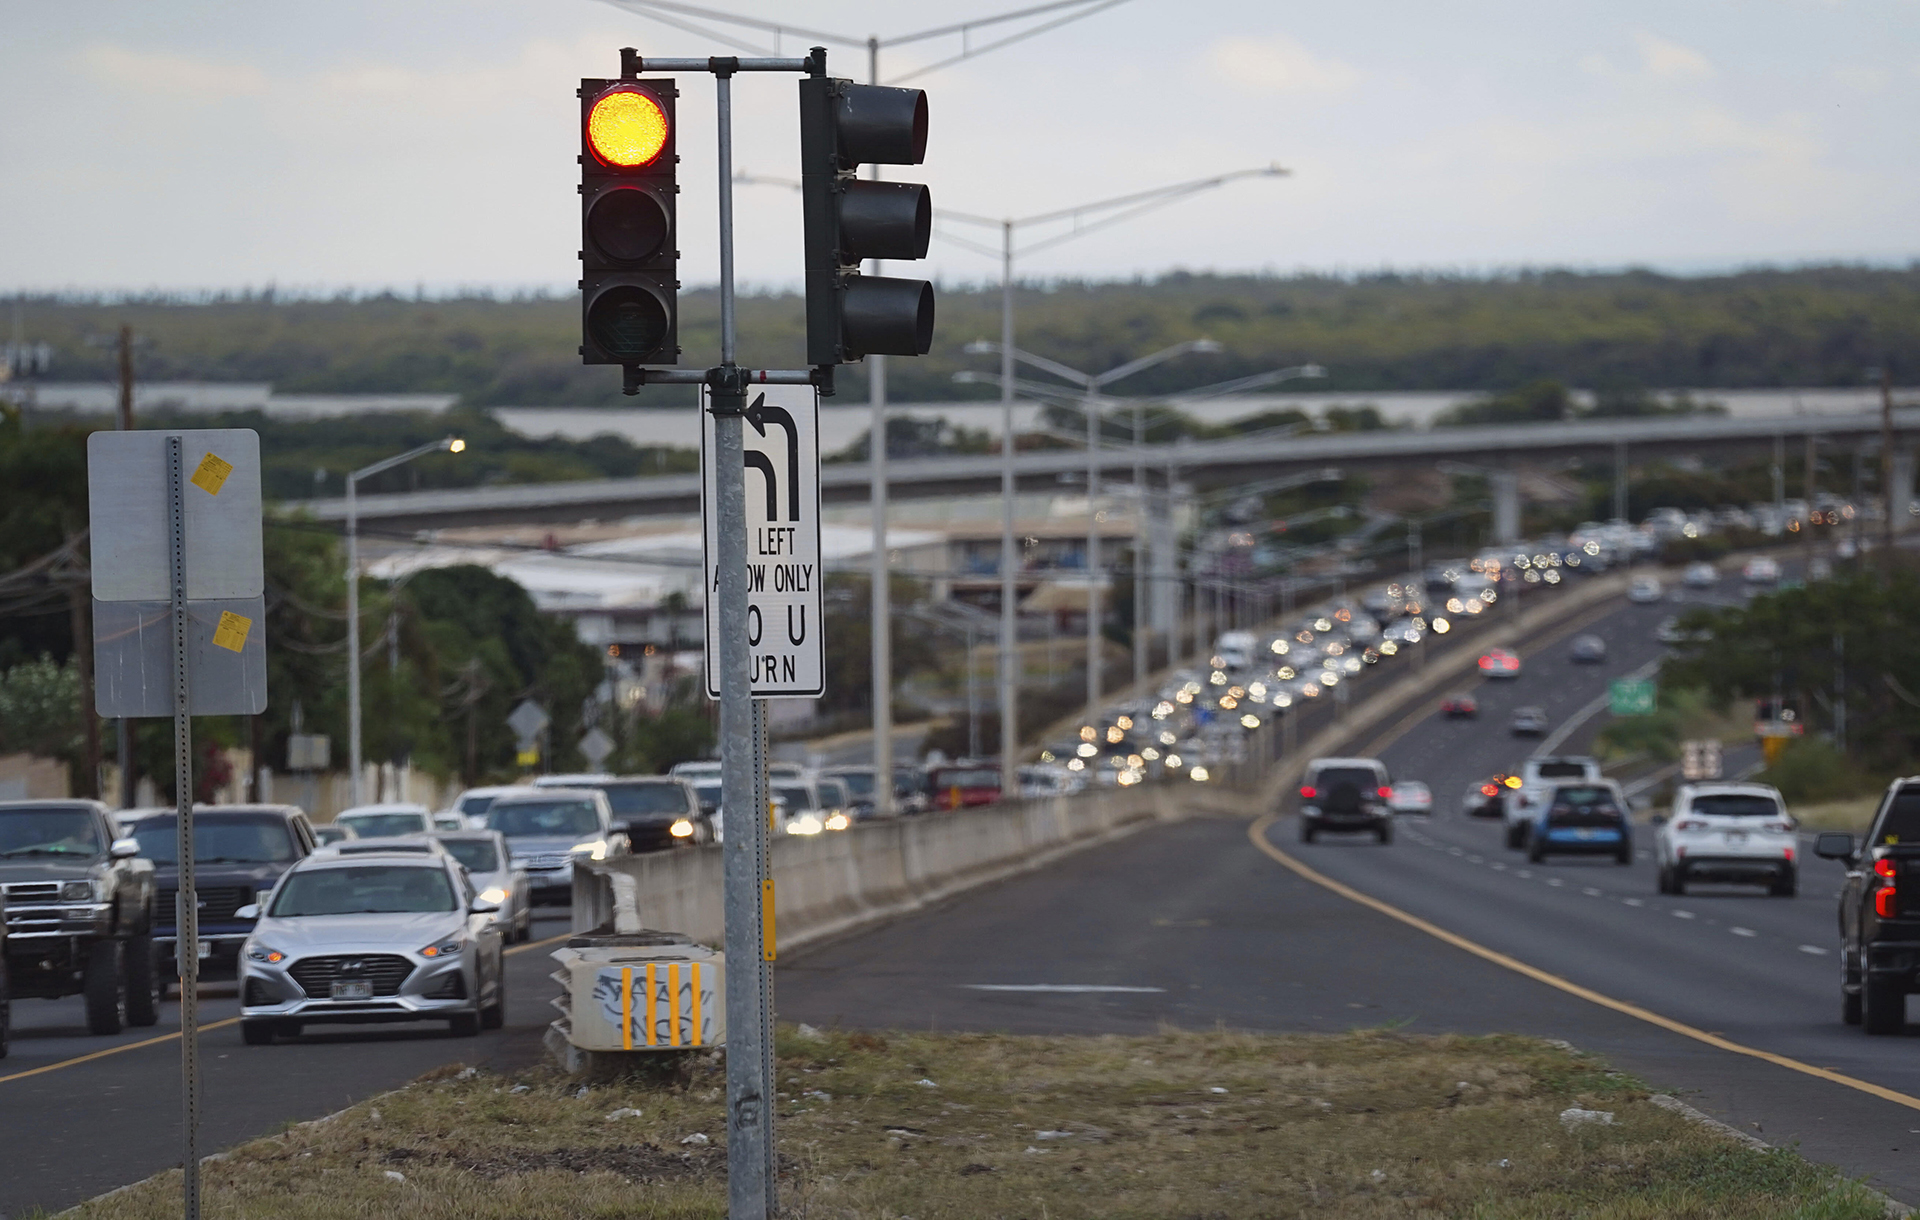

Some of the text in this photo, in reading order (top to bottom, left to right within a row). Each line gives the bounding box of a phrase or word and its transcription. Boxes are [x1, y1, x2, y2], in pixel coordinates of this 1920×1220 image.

[758, 527, 796, 556] LEFT
[774, 563, 813, 593] ONLY
[747, 604, 806, 647] O U
[750, 655, 796, 684] URN
